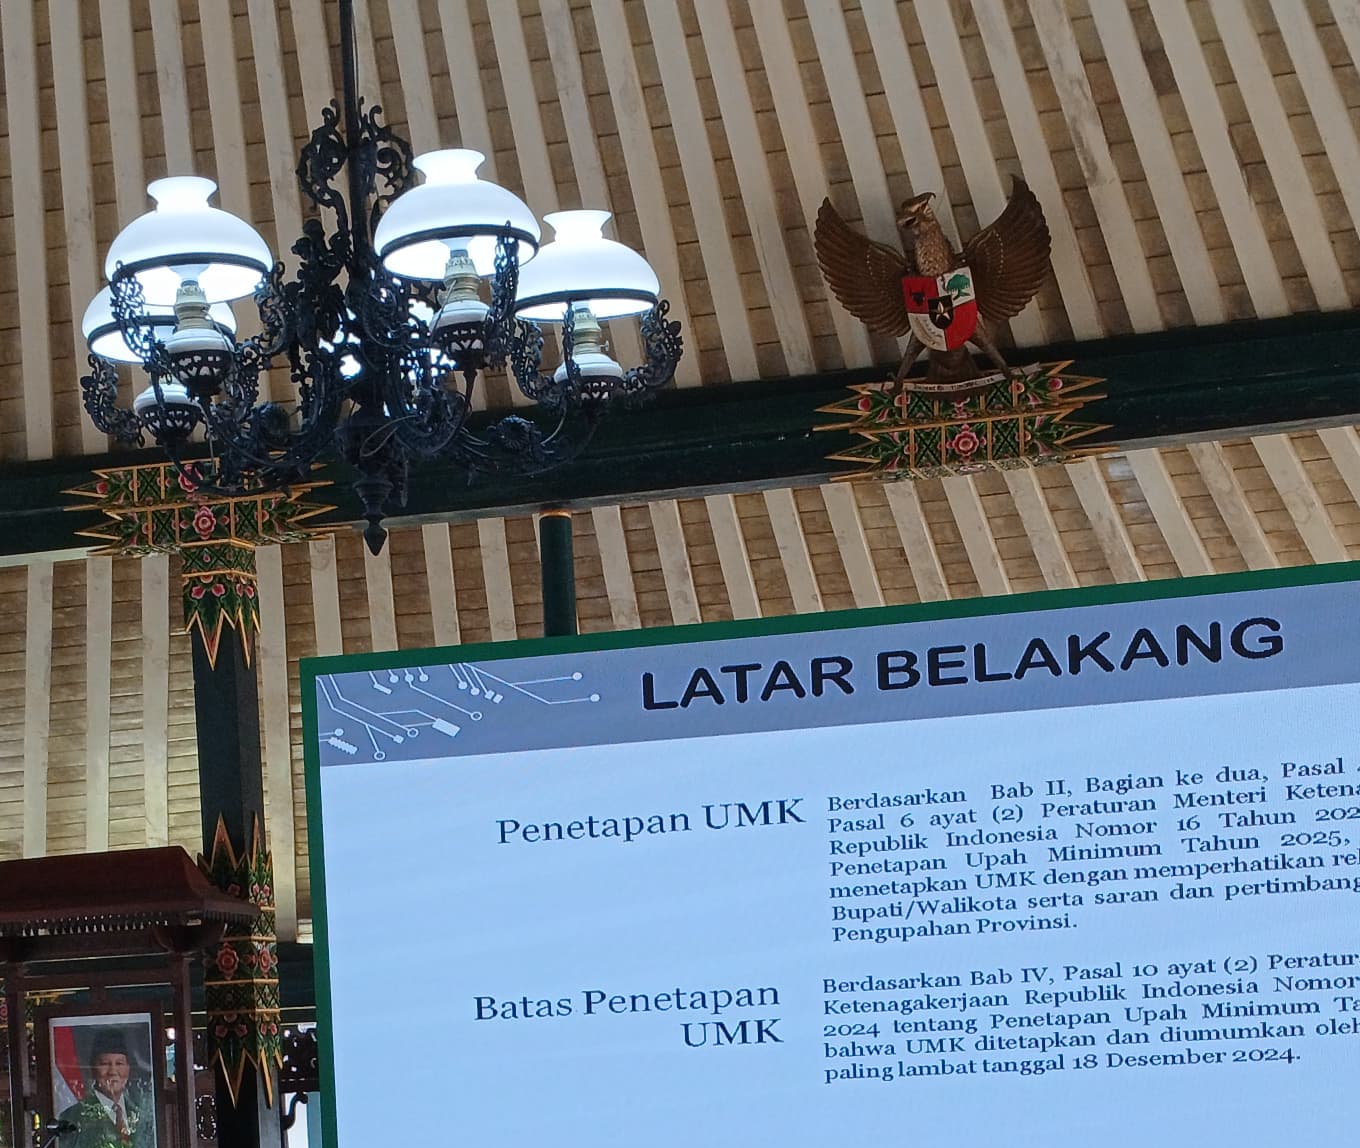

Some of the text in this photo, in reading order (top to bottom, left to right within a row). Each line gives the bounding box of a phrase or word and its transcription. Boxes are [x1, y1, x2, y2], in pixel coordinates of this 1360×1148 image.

[641, 617, 1285, 711] LATAR BELAKANG
[827, 788, 967, 812] Berdasarkan
[990, 781, 1034, 800] Bab
[1045, 779, 1072, 798] II,
[1085, 773, 1164, 795] Bagian
[1175, 769, 1203, 786] ke
[1215, 766, 1269, 784] dua,
[1280, 757, 1346, 778] Pasal
[495, 798, 807, 844] Penetapan UMK
[827, 813, 885, 833] Pasal
[900, 812, 914, 828] 6
[929, 809, 977, 830] ayat
[992, 804, 1023, 825] (2)
[1040, 799, 1157, 818] Peraturan
[1172, 786, 1267, 809] Menteri
[829, 833, 929, 858] Republik
[945, 825, 1058, 847] Indonesia
[1075, 821, 1158, 838] Nomor
[1177, 814, 1201, 831] 16
[1218, 809, 1297, 828] Tahun
[829, 858, 948, 877] Penetapan
[965, 848, 1028, 871] Upah
[1047, 843, 1163, 862] Minimum
[1180, 834, 1260, 853] Tahun
[1281, 830, 1350, 847] 2025,
[829, 876, 967, 899] menetapkan
[974, 870, 1038, 889] UMK
[1043, 868, 1129, 887] dengan
[1133, 853, 1325, 880] memperhatikan
[832, 896, 1017, 923] Bupati/Walikota
[1027, 892, 1084, 909] serta
[1094, 890, 1159, 905] saran
[1170, 882, 1215, 900] dan
[832, 912, 1077, 944] Pengupahan Provinsi.
[823, 972, 962, 993] Berdasarkan
[970, 968, 1013, 986] Bab
[1020, 967, 1055, 986] IV,
[1062, 961, 1123, 981] Pasal
[1132, 964, 1158, 977] 10
[1168, 959, 1216, 979] ayat
[1224, 955, 1257, 976] (2)
[473, 987, 780, 1021] Batas Penetapan
[824, 992, 1010, 1016] Ketenagakerjaan
[1025, 984, 1127, 1008] Republik
[1141, 977, 1259, 999] Indonesia
[1273, 975, 1360, 992] Nomor
[680, 1018, 784, 1048] UMK
[823, 1022, 881, 1038] 2024
[893, 1018, 978, 1035] tentang
[989, 1012, 1112, 1030] Penetapan
[1124, 1003, 1188, 1026] Upah
[1201, 1000, 1321, 1019] Minimum
[823, 1041, 897, 1058] bahwa
[906, 1037, 966, 1054] UMK
[974, 1031, 1096, 1053] ditetapkan
[1106, 1028, 1150, 1045] dan
[1160, 1021, 1305, 1043] diumumkan
[824, 1047, 1301, 1084] paling lambat tanggal 18 Desember 2024.
